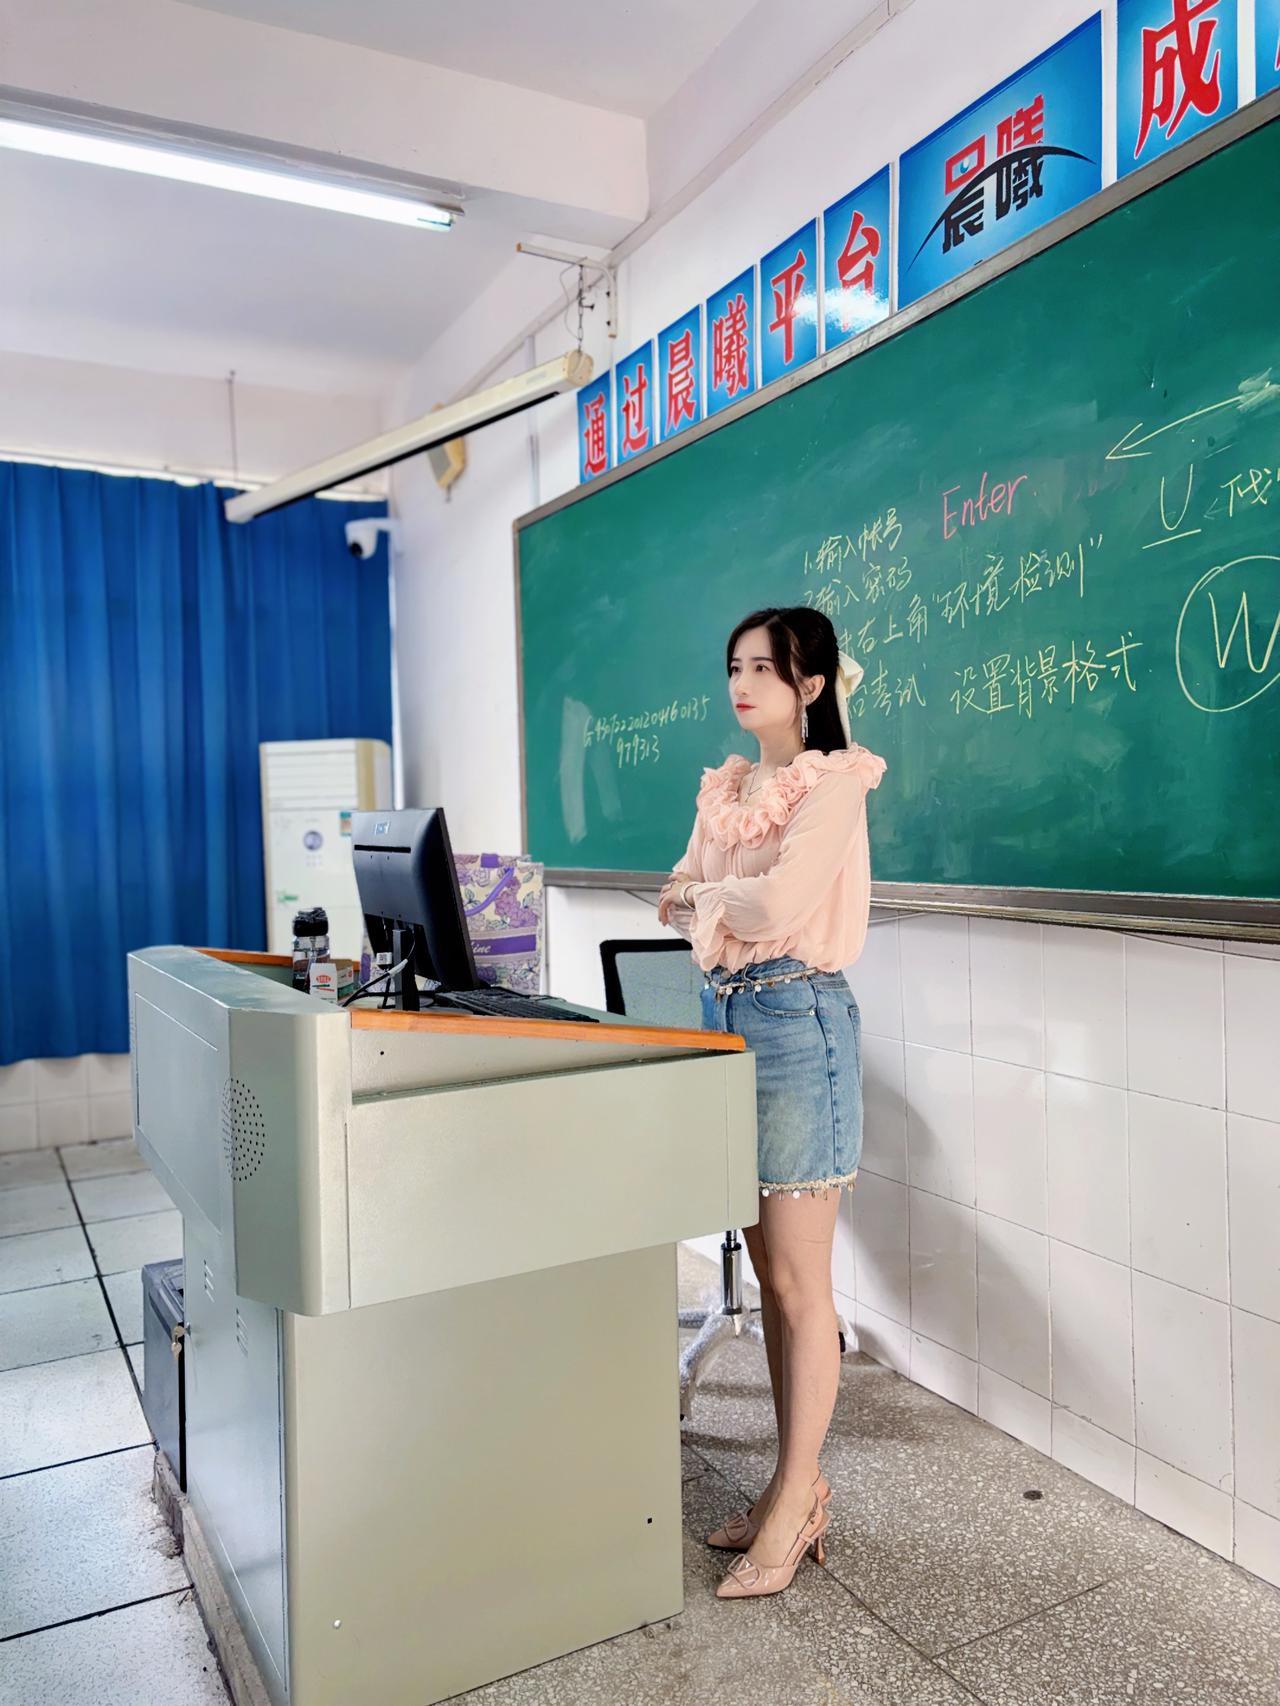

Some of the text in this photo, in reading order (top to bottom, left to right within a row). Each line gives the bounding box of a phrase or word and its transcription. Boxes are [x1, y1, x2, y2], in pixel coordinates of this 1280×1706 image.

[583, 211, 880, 479] 通过晨曦平台
[942, 471, 1029, 540] Enter
[1160, 463, 1194, 530] U
[950, 631, 1144, 719] 设置背景格式
